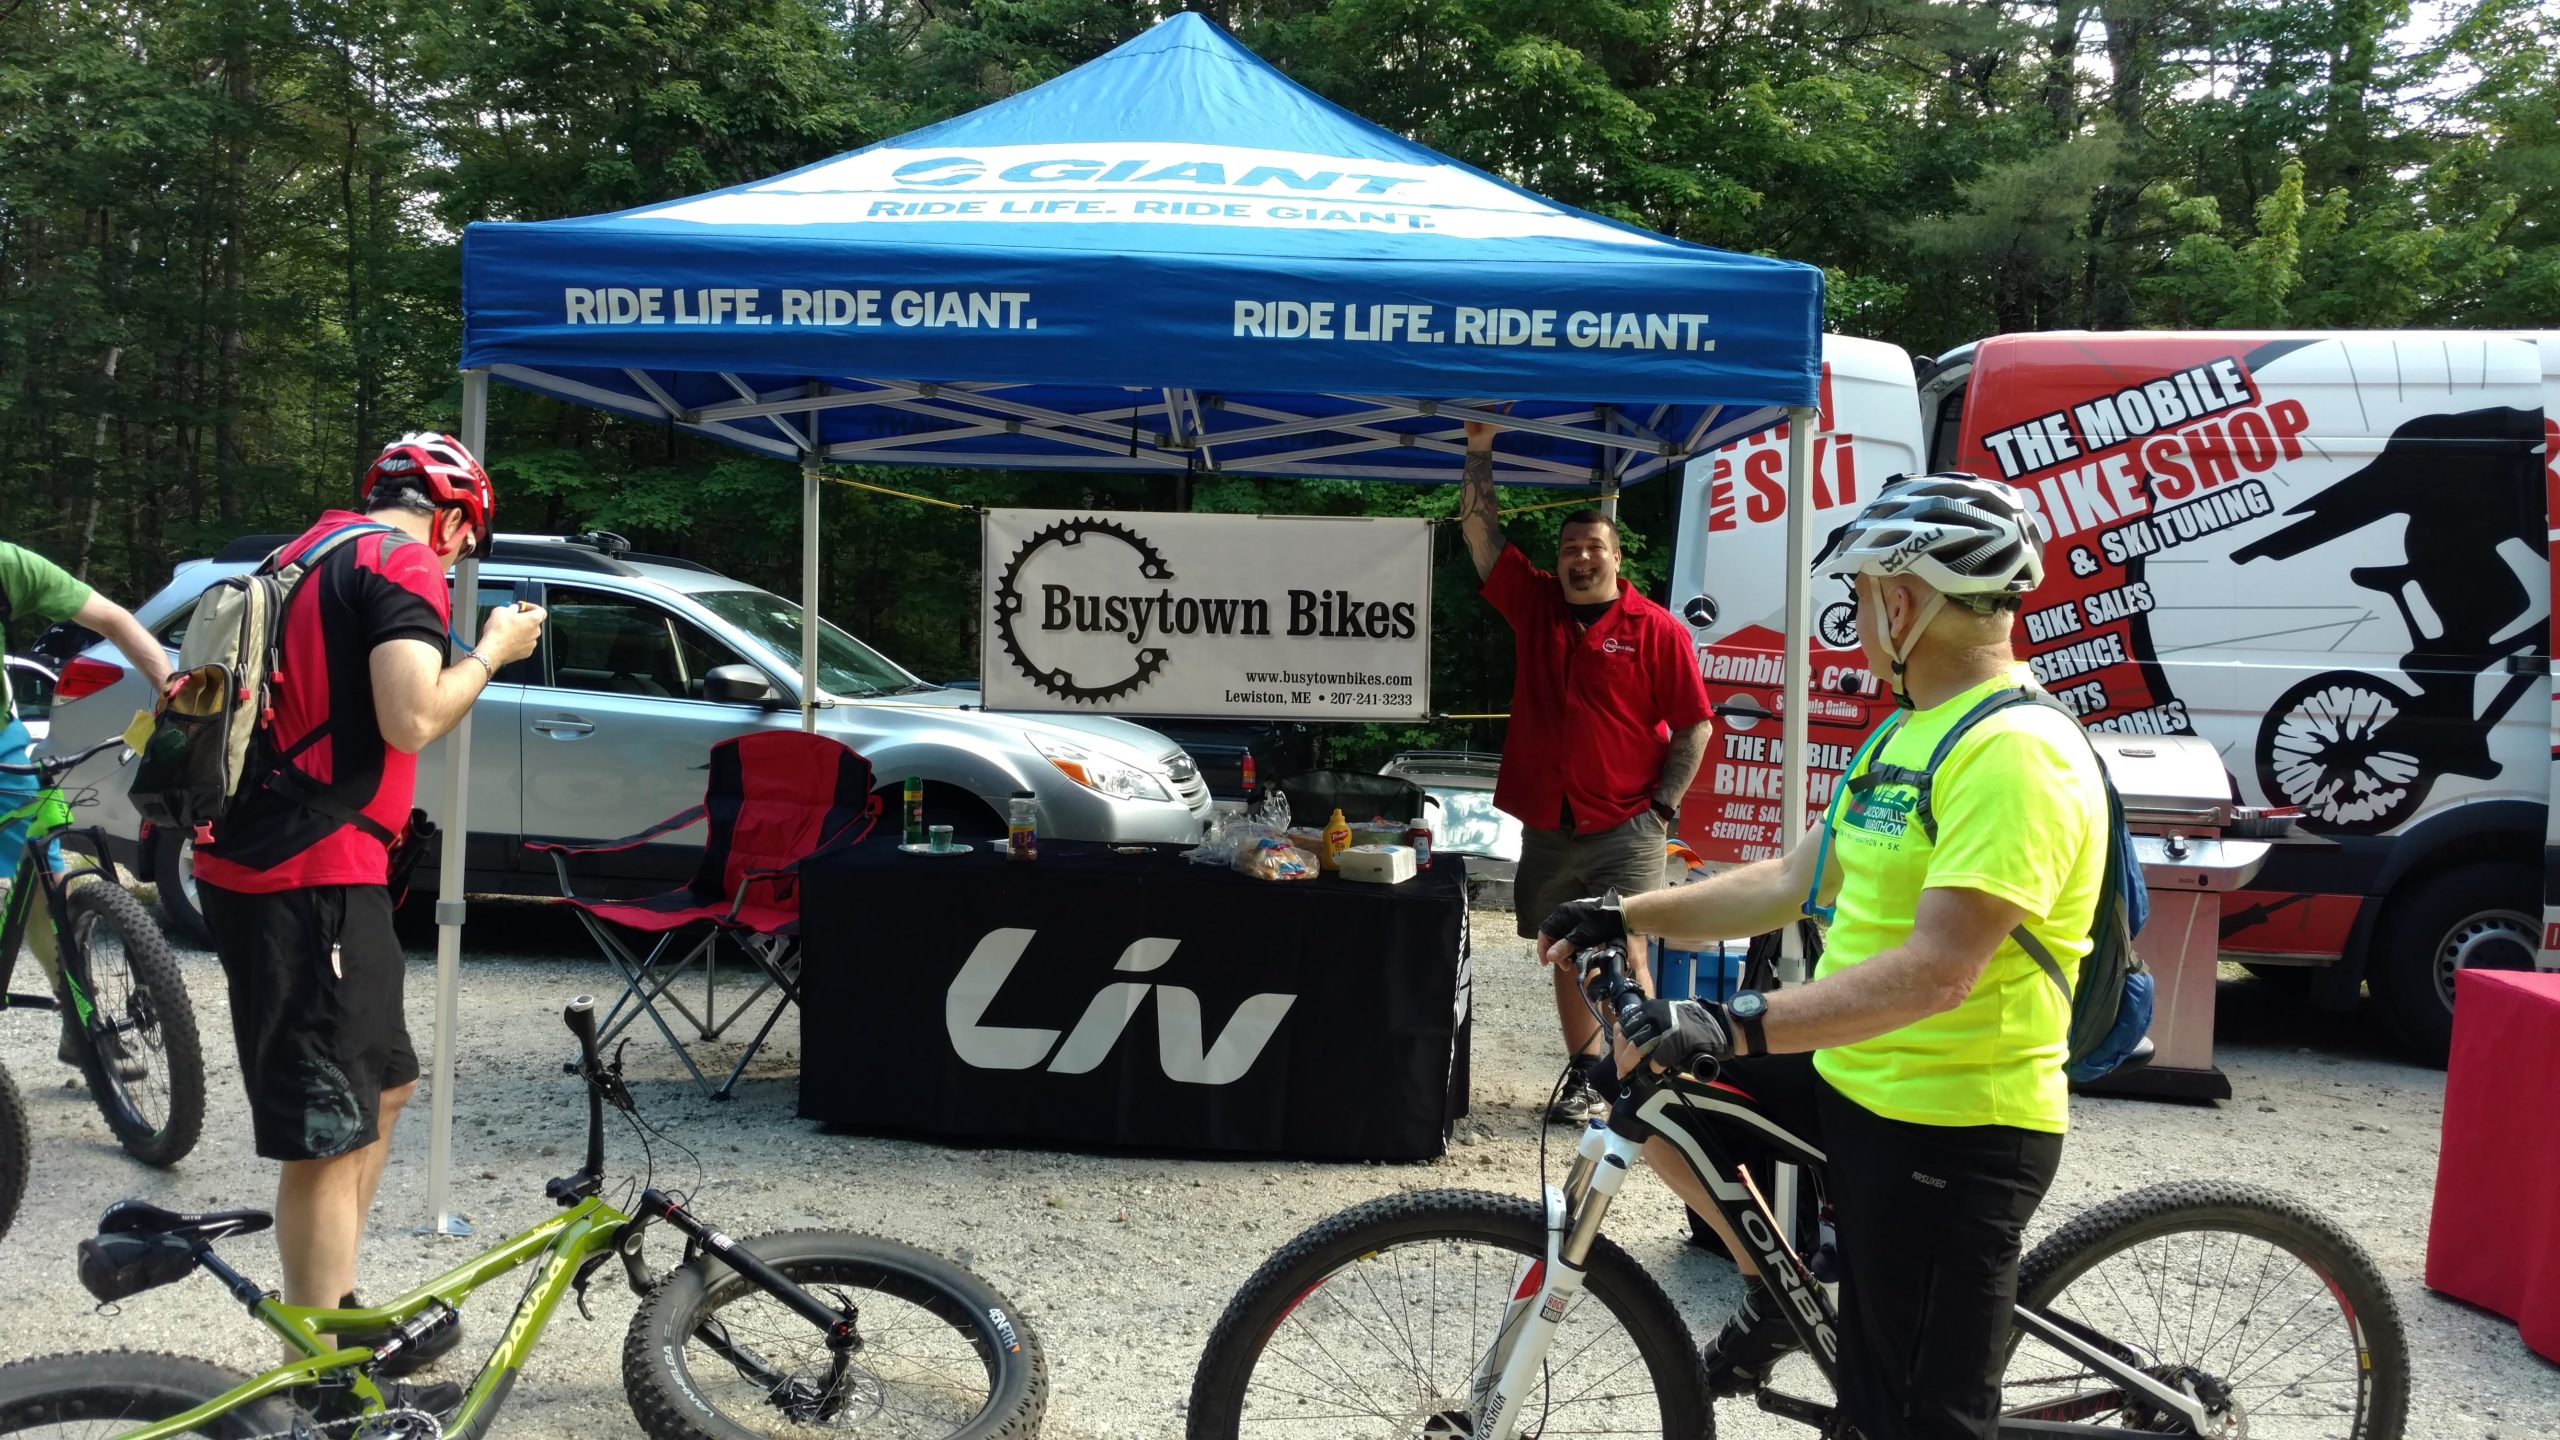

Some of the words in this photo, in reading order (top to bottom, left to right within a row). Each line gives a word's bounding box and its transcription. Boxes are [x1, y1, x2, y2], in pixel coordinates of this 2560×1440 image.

[998, 159, 1426, 195] GIANT
[867, 200, 988, 217] RIDE
[1000, 200, 1117, 215] LIFE.
[1133, 200, 1251, 217] RIDE
[1267, 206, 1436, 228] GIANT.
[565, 288, 665, 325] RIDE
[673, 289, 772, 326] LIFE.
[782, 290, 882, 328] RIDE
[891, 291, 1038, 330] GIANT.
[1233, 300, 1335, 340] RIDE
[1344, 303, 1444, 344] LIFE.
[1454, 307, 1557, 347] RIDE
[1566, 310, 1716, 352] GIANT.
[1984, 413, 2080, 478] THE
[2074, 359, 2250, 450] MOBILE
[2147, 399, 2310, 501] SHOP
[1900, 527, 1944, 559] KALI
[2070, 548, 2099, 577] &
[2101, 520, 2157, 564] SKI
[2154, 483, 2271, 546] TUNING
[1041, 583, 1271, 645] Busytown
[1287, 589, 1416, 641] Bikes
[2025, 602, 2082, 643] BIKE
[2084, 582, 2153, 625] SALES
[2029, 633, 2126, 685] SERVICE
[1246, 670, 1413, 687] www.busytownbikes.com
[1225, 690, 1287, 705] Lewiston,
[1291, 691, 1311, 704] ME
[1330, 692, 1413, 706] 207-241-3233
[1825, 700, 1859, 718] Online
[2053, 681, 2107, 717] RTS
[1724, 733, 1766, 762] THE
[1769, 739, 1853, 771] MBILE
[1713, 763, 1784, 800] BIKE
[1724, 802, 1755, 821] BIKE
[1711, 821, 1766, 842] SERVICE
[1887, 842, 1900, 852] 5K
[1741, 845, 1773, 861] BIKE
[946, 927, 1298, 1085] Liv
[1547, 1296, 1567, 1311] ROCK
[1741, 1209, 1837, 1364] ORBE
[989, 1308, 1019, 1349] 45NRTH
